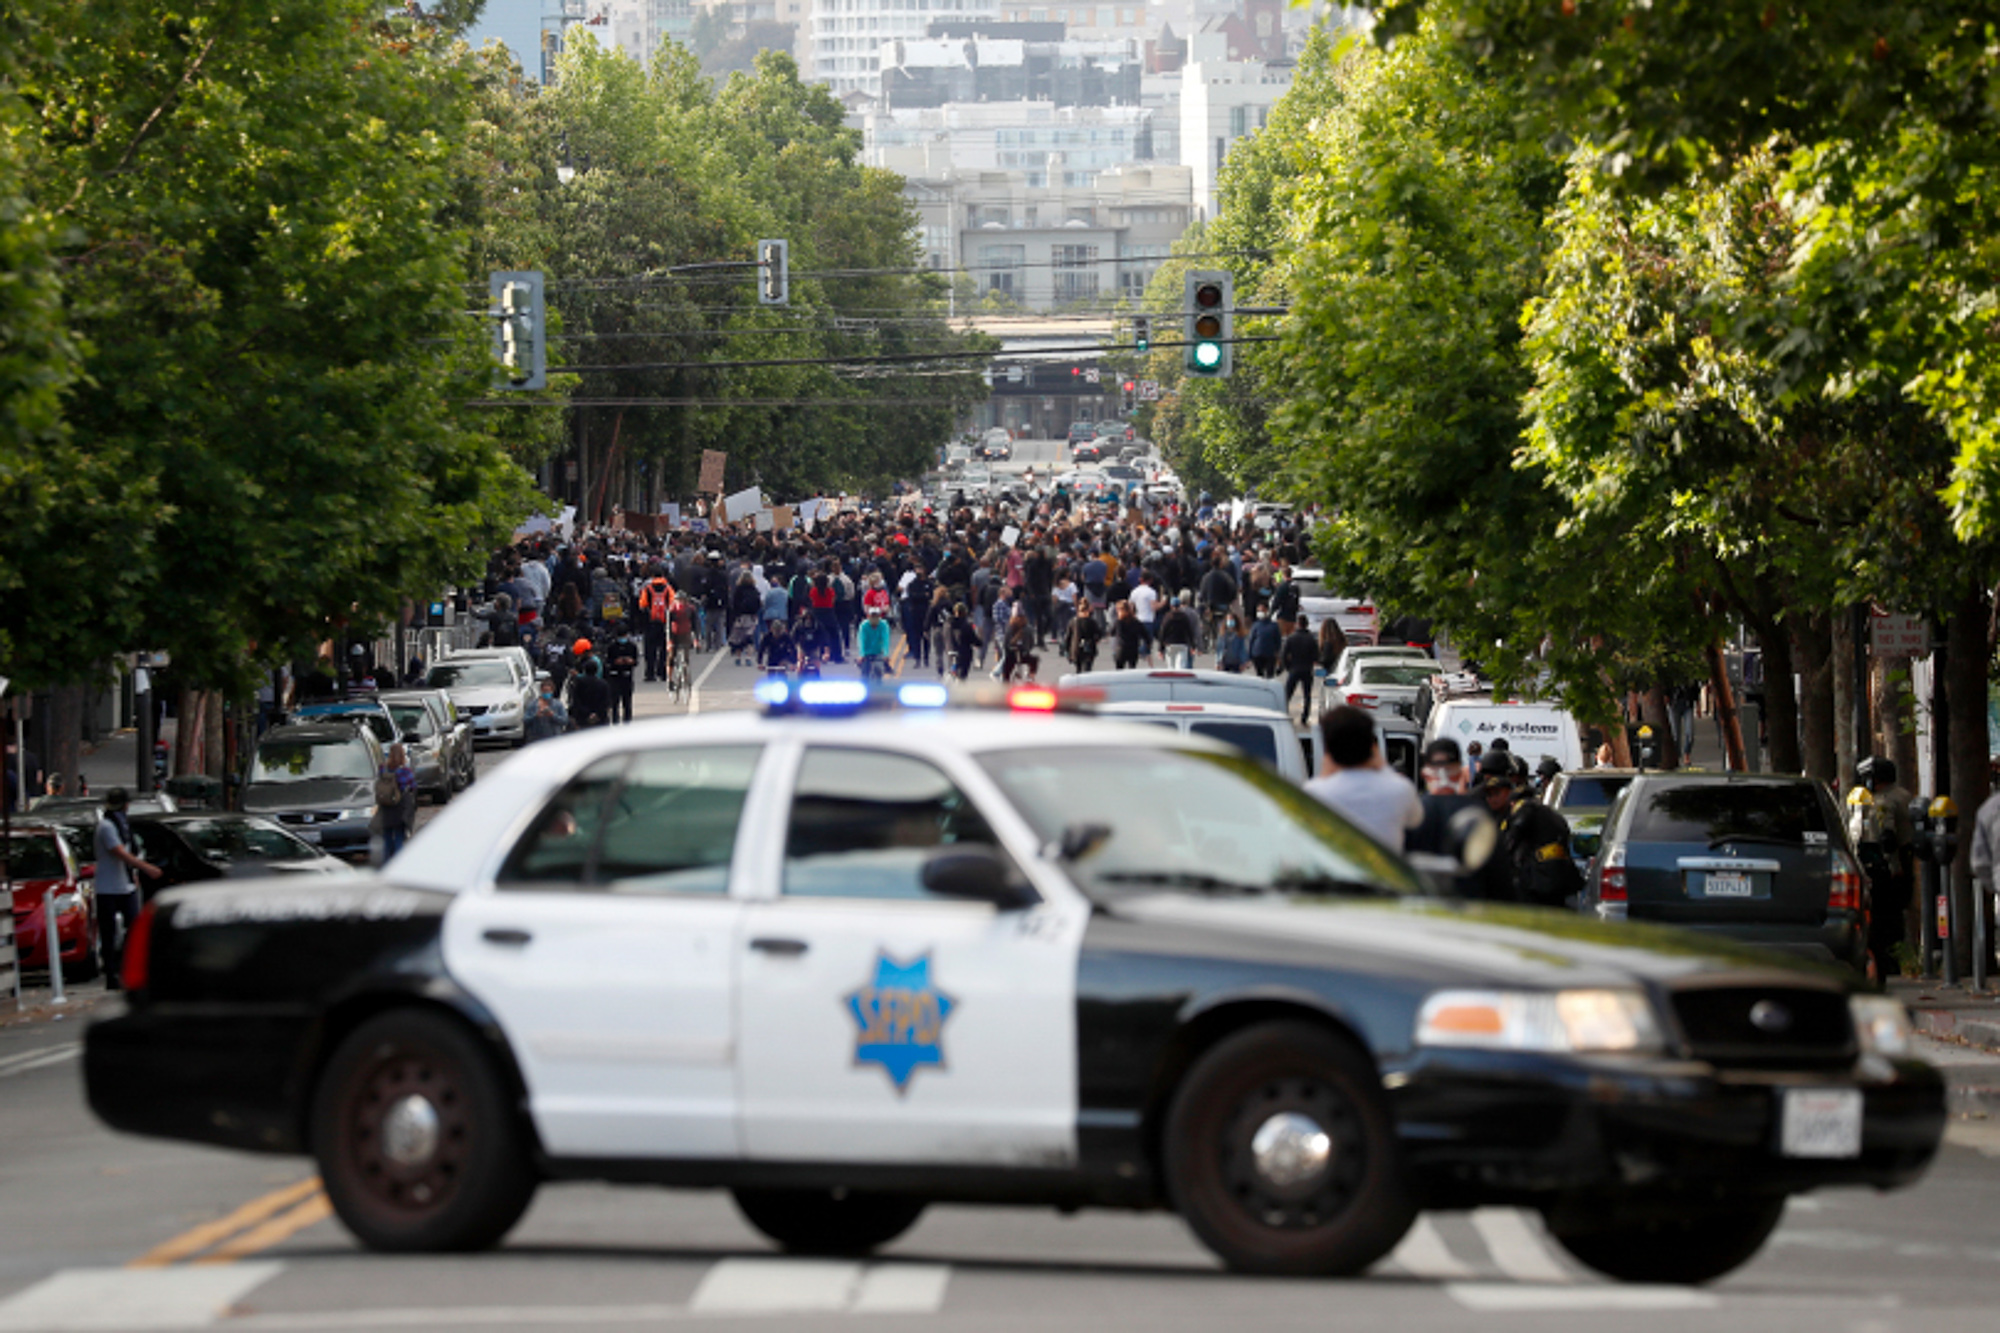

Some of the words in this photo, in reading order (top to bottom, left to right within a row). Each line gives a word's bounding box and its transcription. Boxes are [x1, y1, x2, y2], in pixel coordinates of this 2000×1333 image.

[1476, 721, 1497, 732] Air
[1500, 720, 1559, 736] Systems
[858, 987, 941, 1044] SFPD
